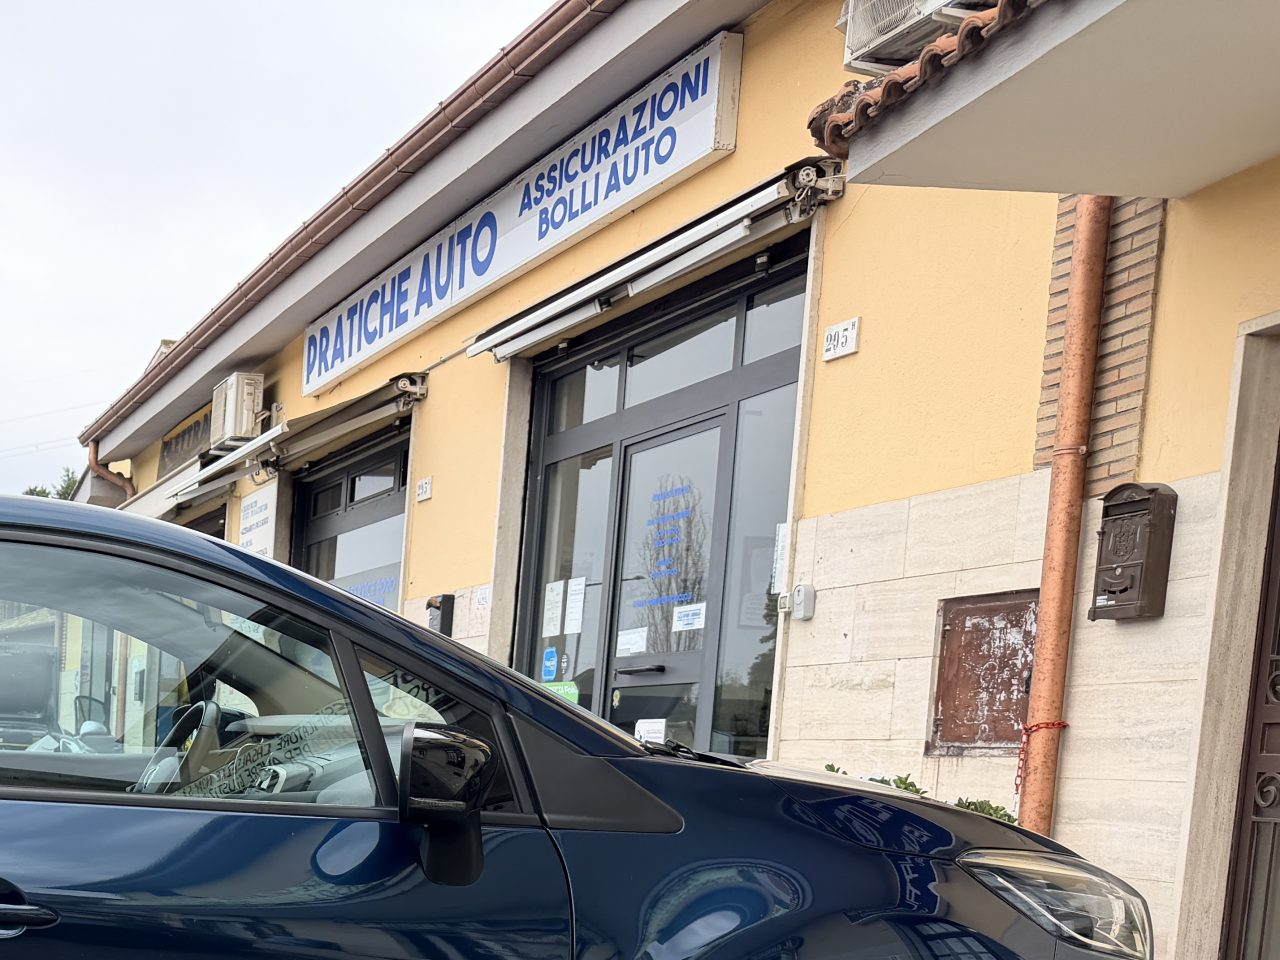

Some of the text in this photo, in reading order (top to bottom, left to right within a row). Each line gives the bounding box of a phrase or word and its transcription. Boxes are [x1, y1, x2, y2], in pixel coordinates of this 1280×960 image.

[518, 56, 710, 217] ASSICURAZIONI
[538, 126, 677, 241] BOLLI AUTO
[305, 211, 498, 385] PRATICHE AUTO
